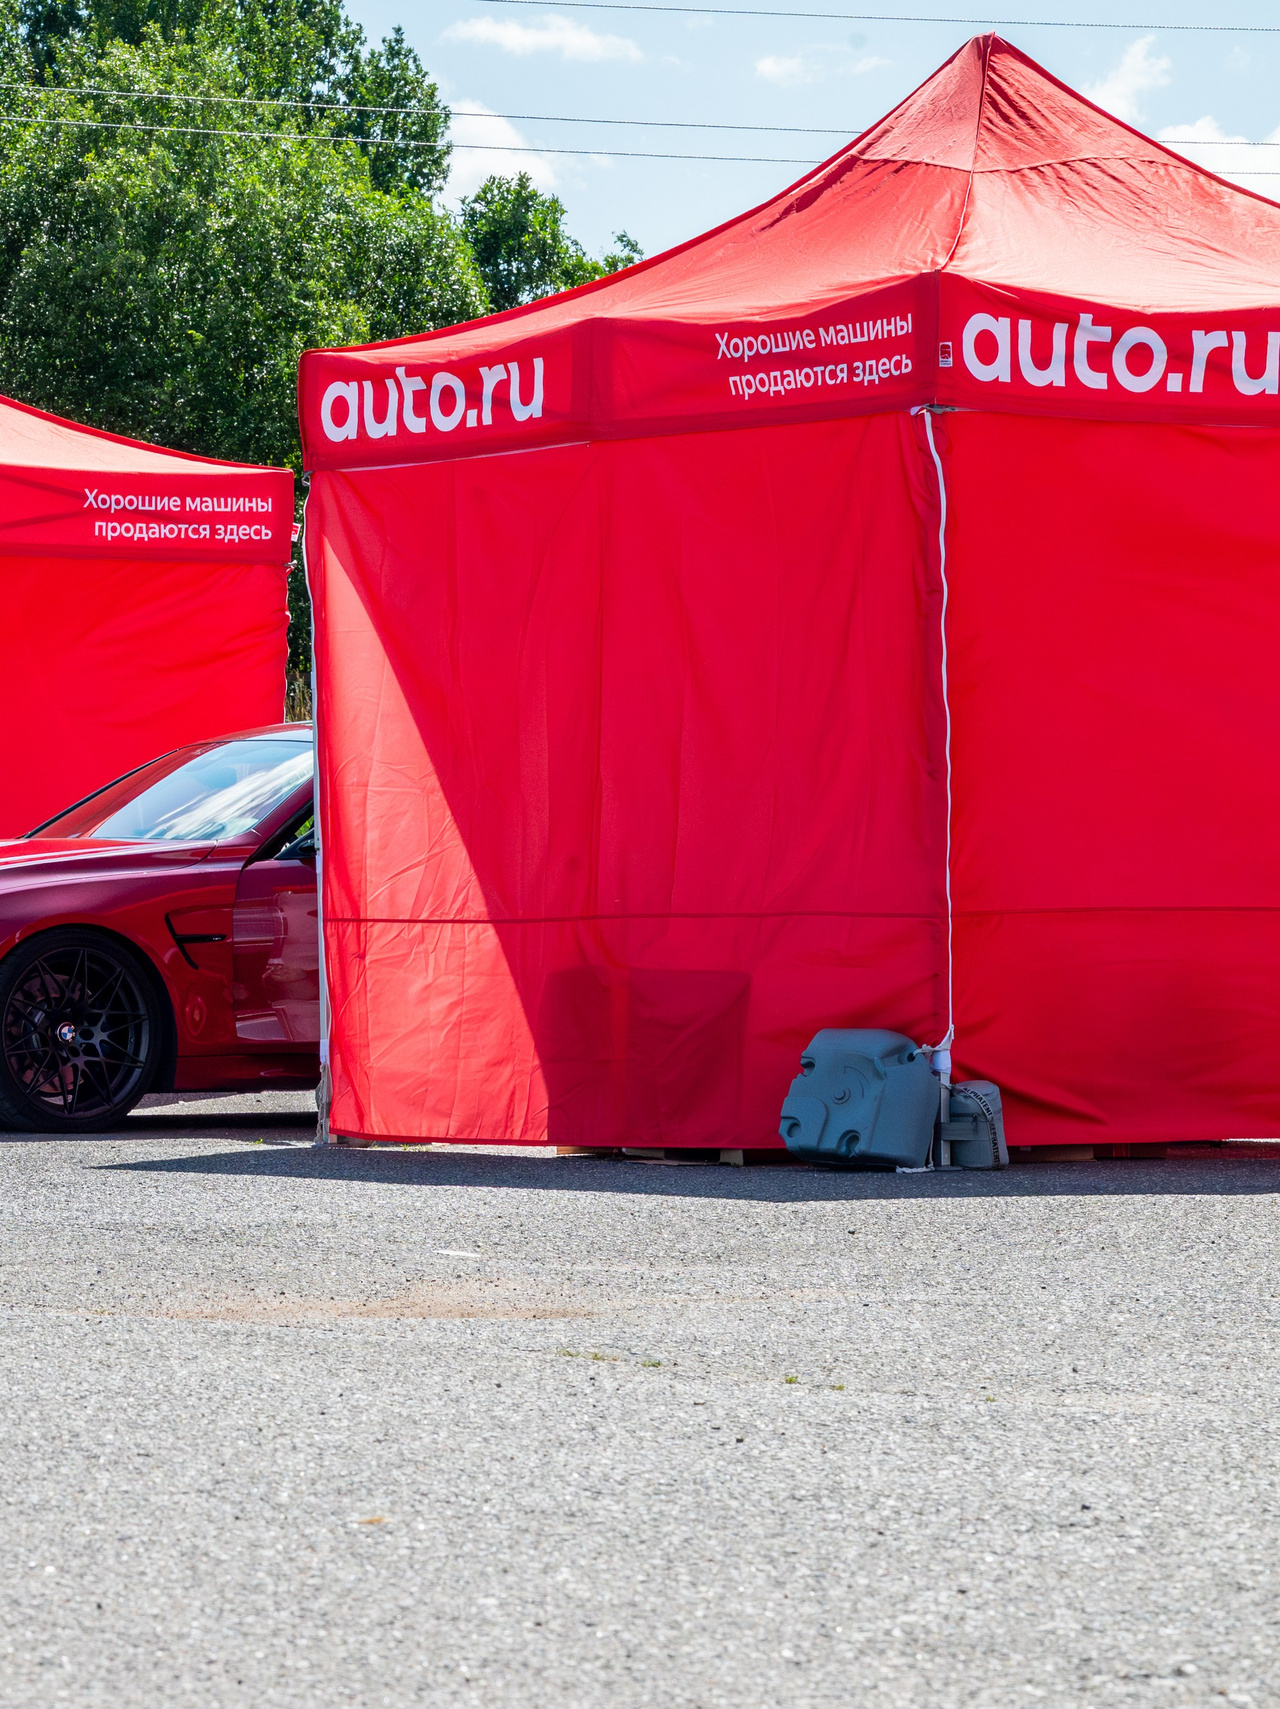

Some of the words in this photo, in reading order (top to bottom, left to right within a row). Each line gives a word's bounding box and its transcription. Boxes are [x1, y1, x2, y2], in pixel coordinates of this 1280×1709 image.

[715, 332, 816, 362] Хорошие
[819, 313, 912, 347] машины
[962, 313, 1280, 395] auto.ru
[321, 357, 544, 442] auto.ru
[729, 364, 848, 400] продаются
[853, 354, 912, 386] здесь
[83, 488, 181, 513] Хорошие
[185, 497, 272, 513] машины
[94, 521, 210, 542] продаются
[214, 524, 272, 542] здесь
[963, 1087, 994, 1117] ALPHATENT
